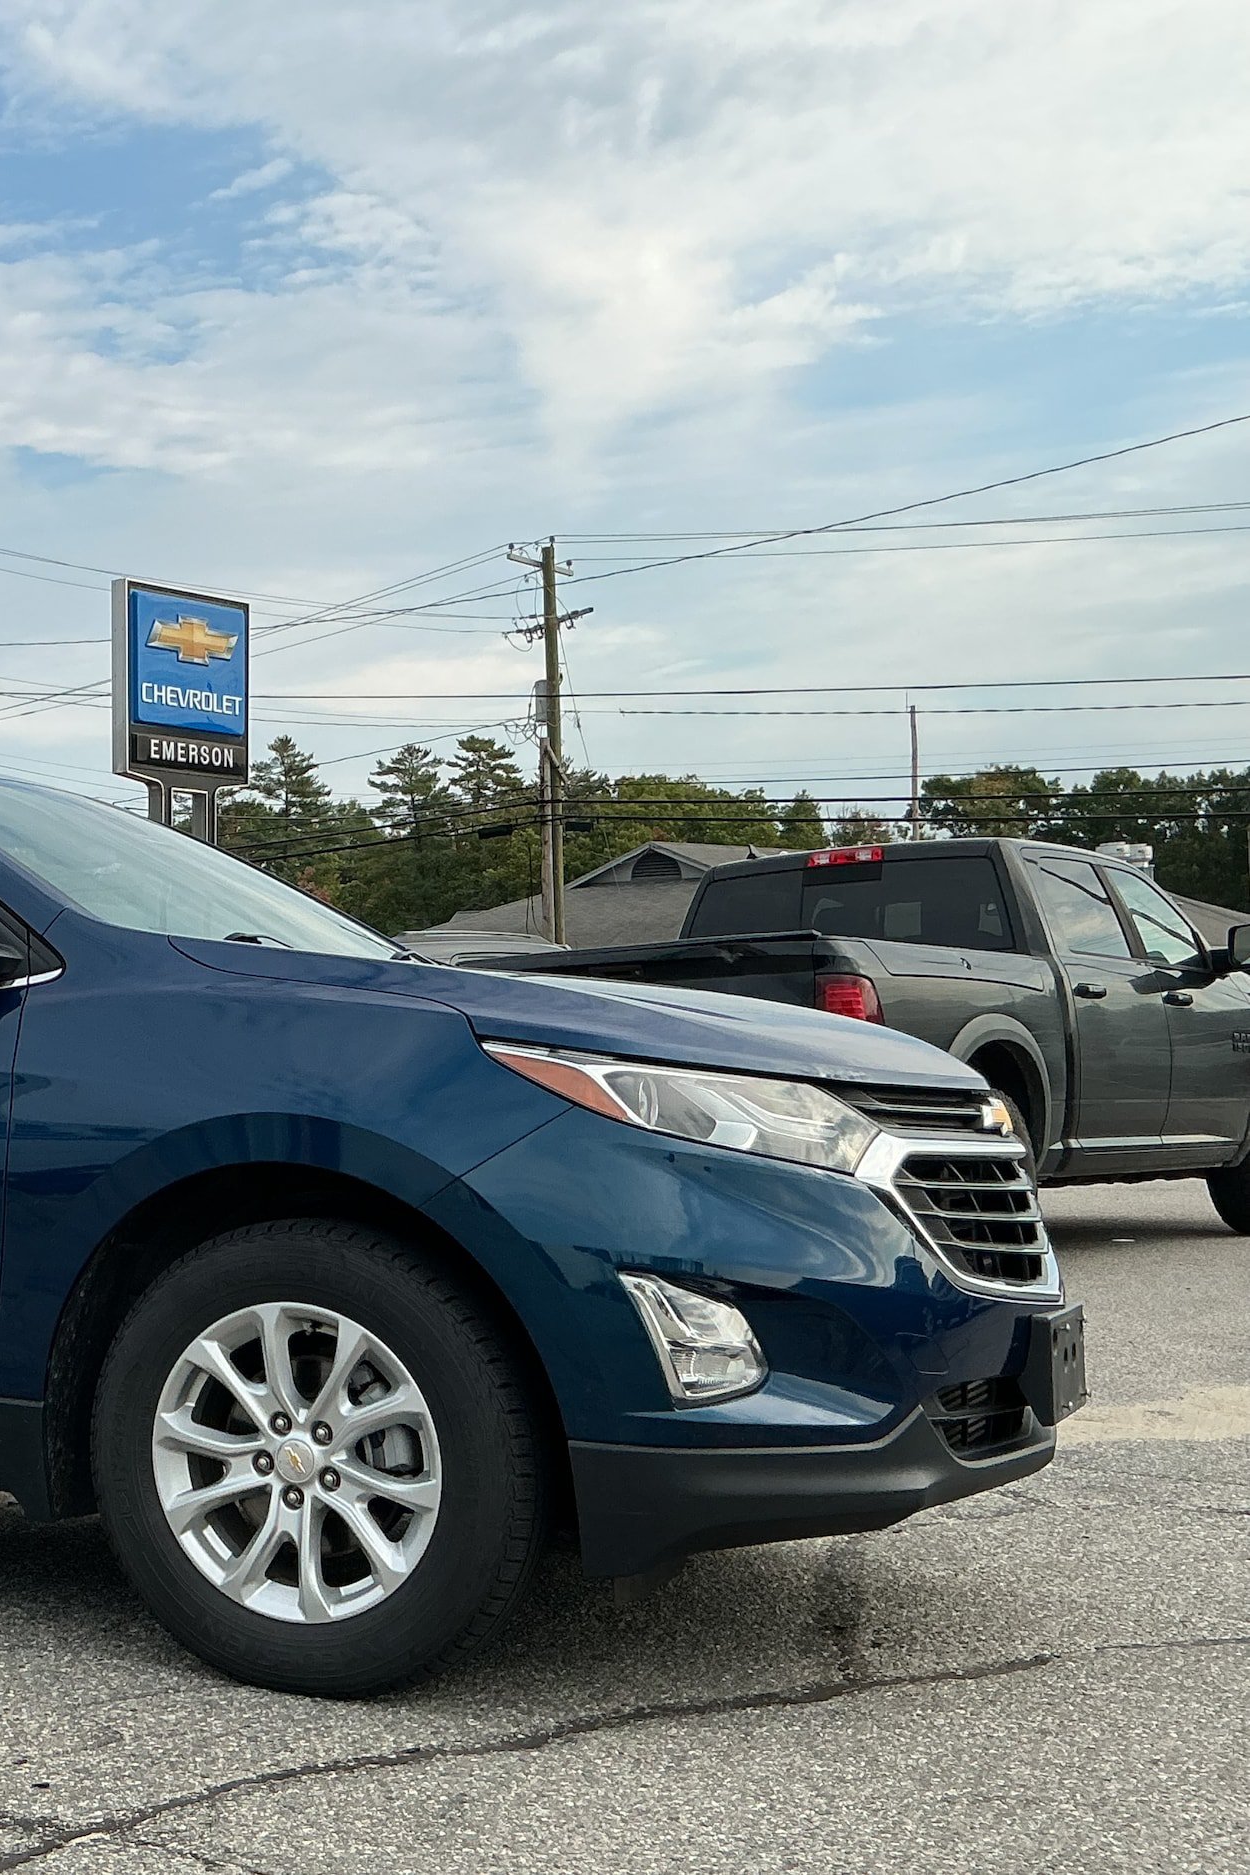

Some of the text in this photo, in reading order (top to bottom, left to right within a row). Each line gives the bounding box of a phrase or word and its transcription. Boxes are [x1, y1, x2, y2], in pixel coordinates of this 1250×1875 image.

[141, 682, 243, 716] CHEVROLET
[150, 738, 234, 769] EMERSON
[1233, 1032, 1250, 1042] RA
